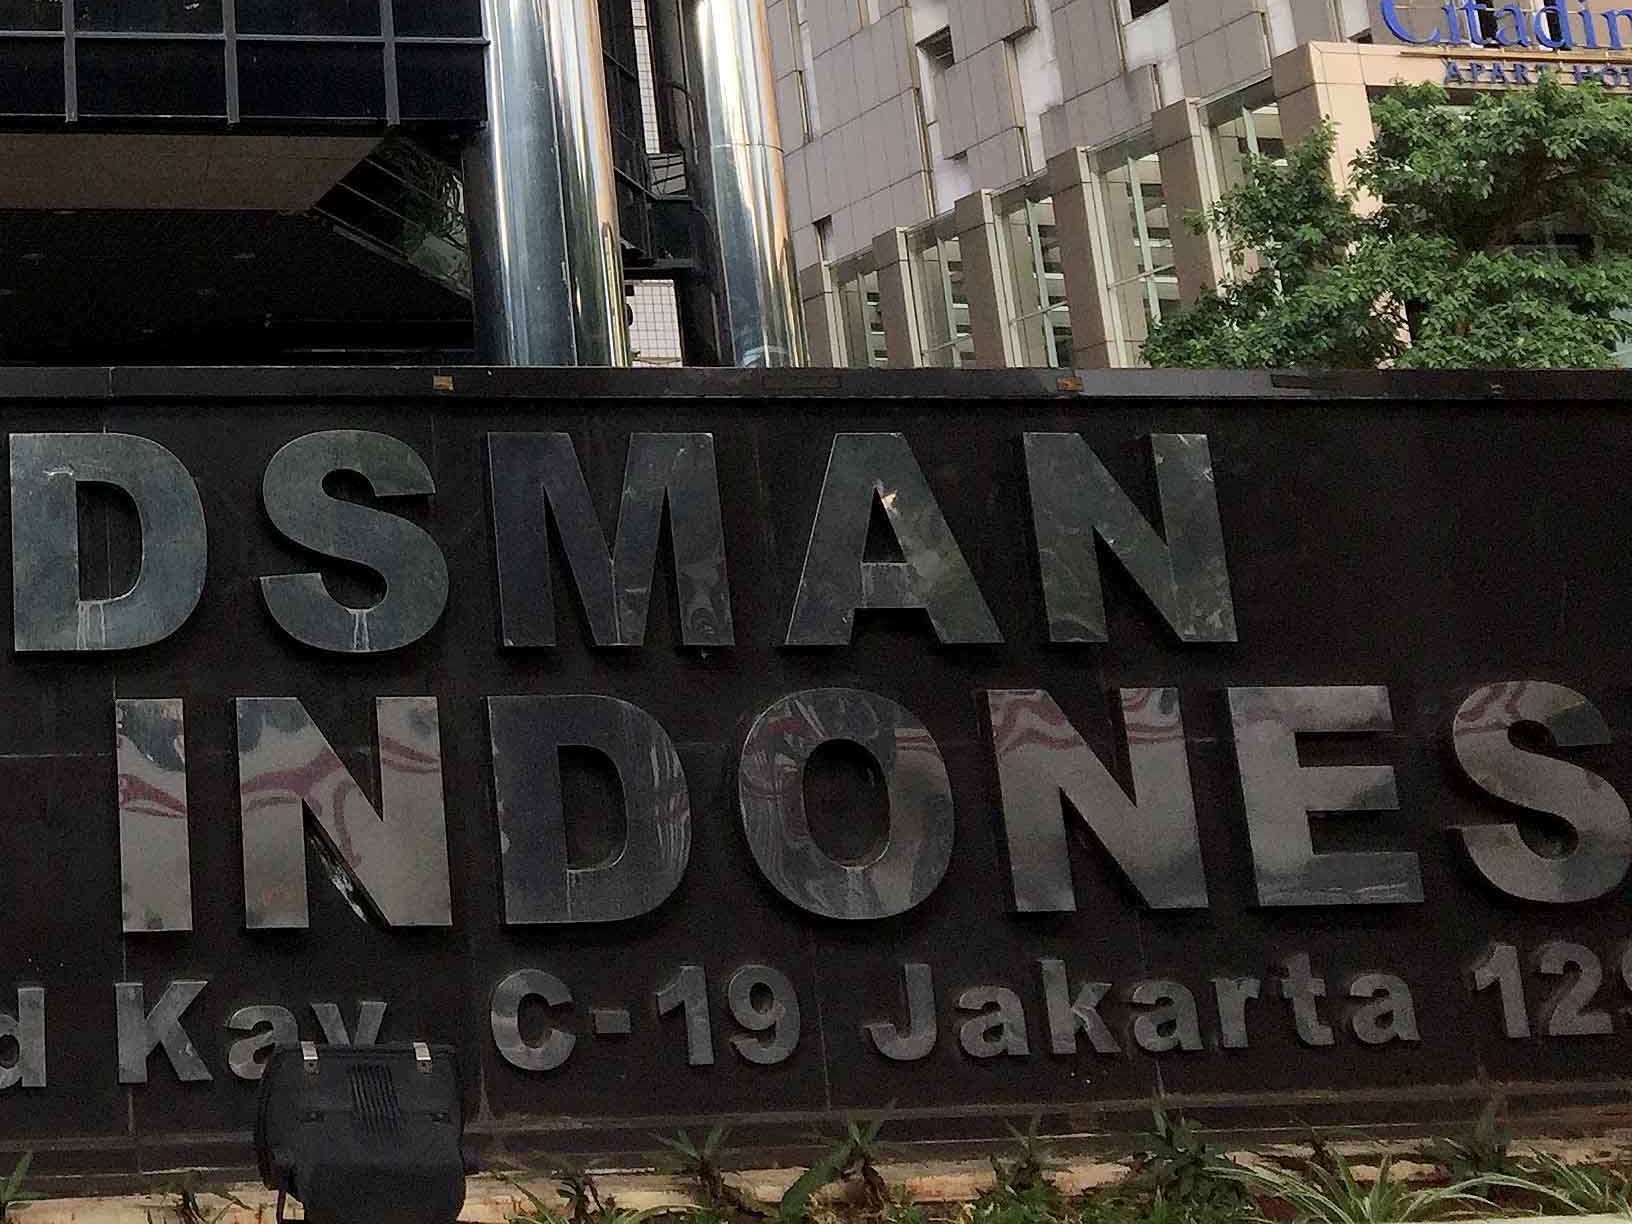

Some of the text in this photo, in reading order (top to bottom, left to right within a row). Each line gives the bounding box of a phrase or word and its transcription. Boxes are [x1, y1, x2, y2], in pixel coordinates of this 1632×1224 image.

[113, 678, 1632, 933] INDONES
[488, 964, 801, 1072] C-19
[865, 951, 1423, 1061] Jakarta
[1471, 941, 1632, 1040] 12
